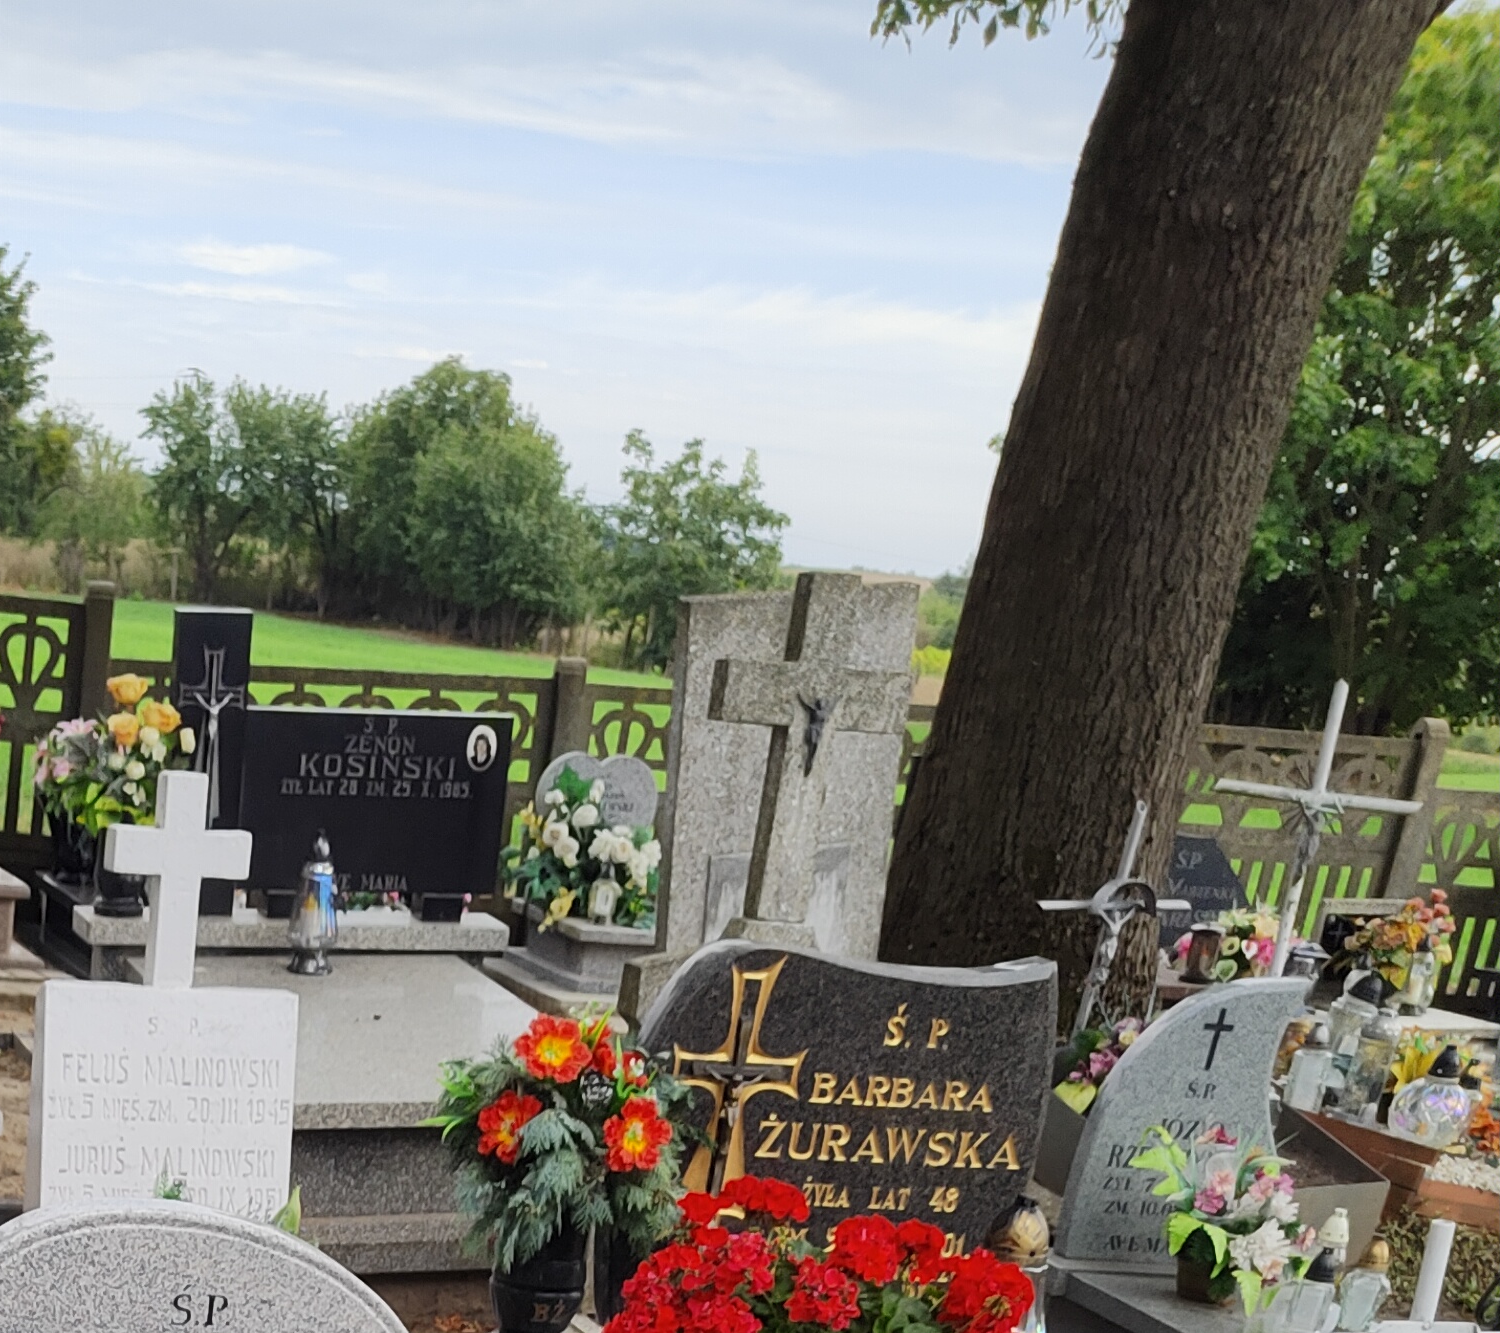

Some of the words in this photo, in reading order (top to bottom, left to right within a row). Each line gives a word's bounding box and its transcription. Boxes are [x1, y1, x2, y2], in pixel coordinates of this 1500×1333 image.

[343, 735, 416, 755] ZENON
[307, 778, 334, 796] LAT
[883, 1002, 912, 1049] Ś.
[927, 1017, 949, 1050] P.
[144, 1054, 281, 1089] MALINOWSKI
[808, 1071, 994, 1114] BARBARA
[754, 1111, 1022, 1172] ŻURAWSKA
[141, 1145, 276, 1178] MALINOWSKI
[867, 1186, 912, 1211] LAT
[928, 1185, 961, 1214] 48
